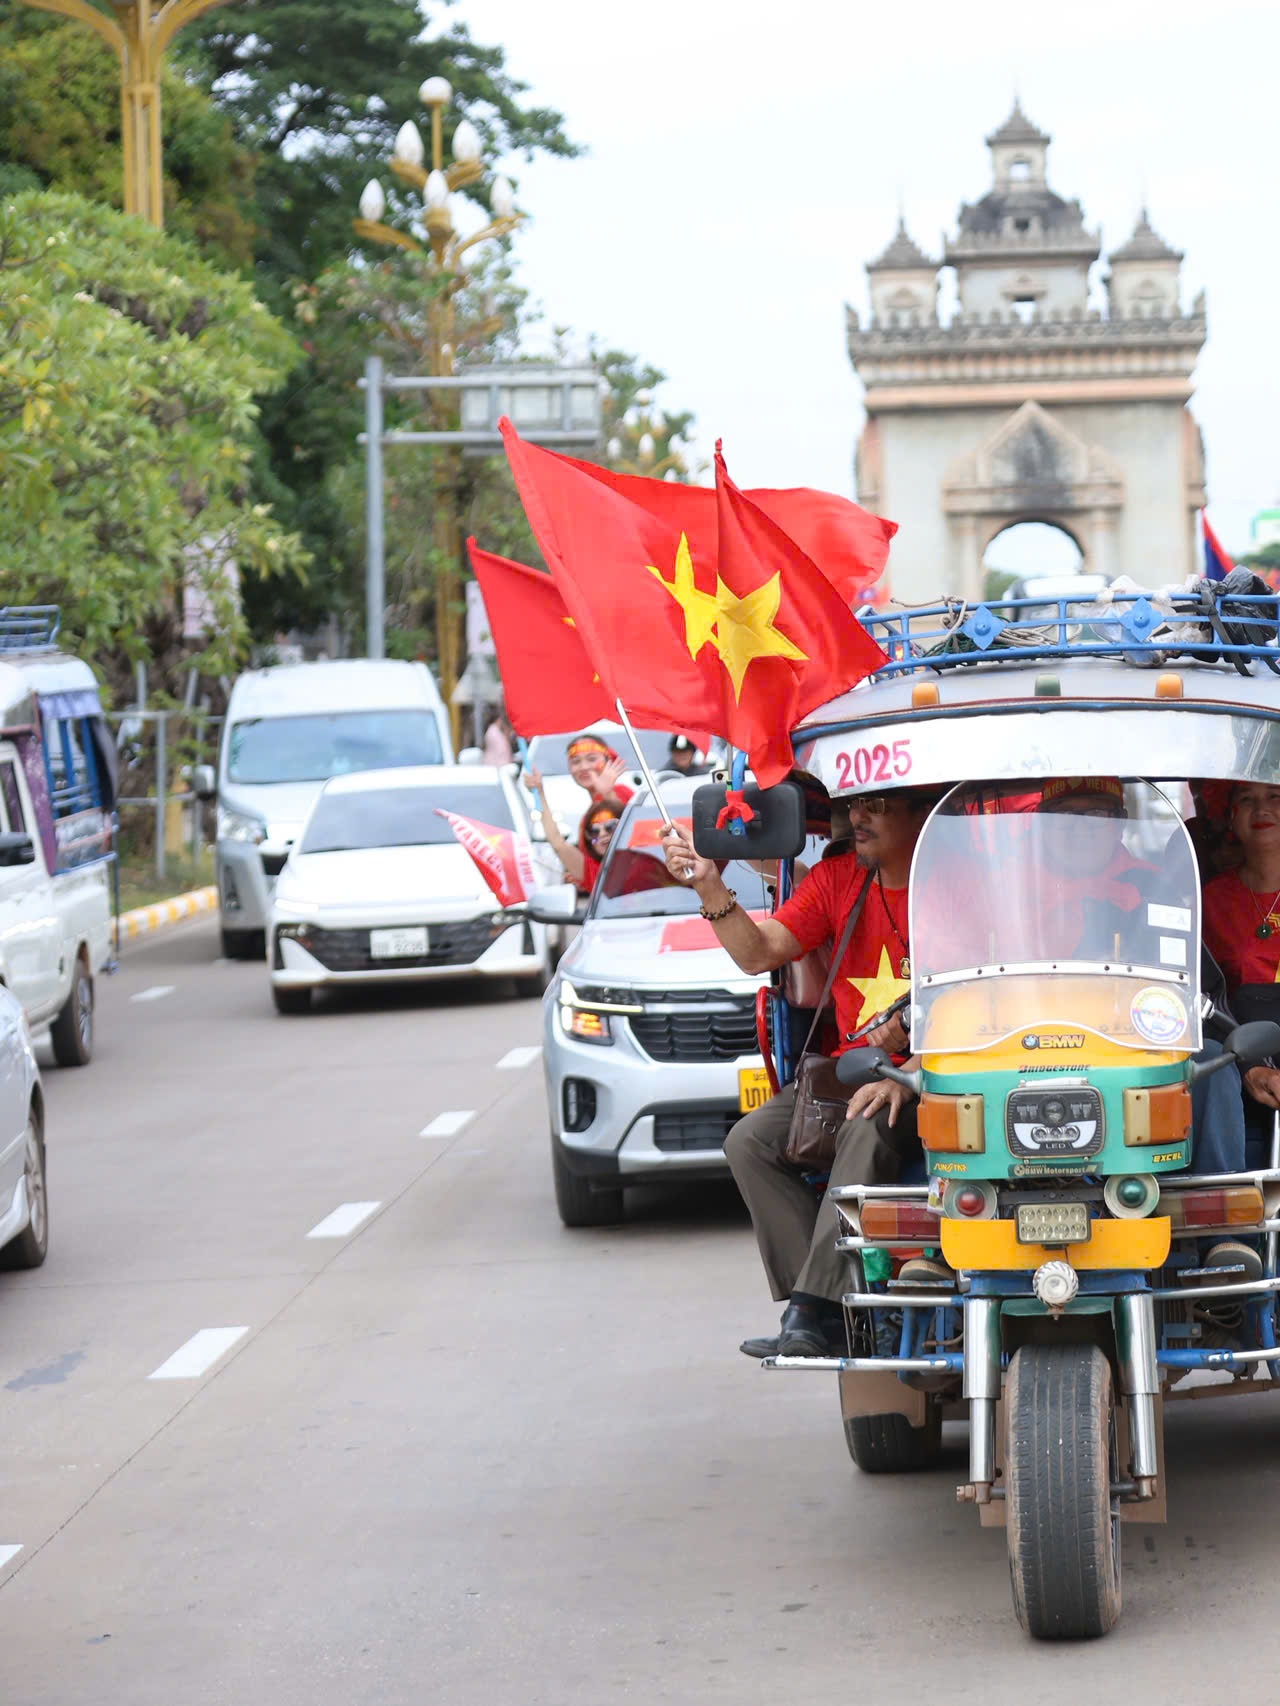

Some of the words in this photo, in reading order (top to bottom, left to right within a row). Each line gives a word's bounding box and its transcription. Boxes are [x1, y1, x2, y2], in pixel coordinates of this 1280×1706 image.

[835, 739, 912, 789] 2025
[1038, 1034, 1085, 1049] BMW
[1018, 1064, 1091, 1074] BRIDGESTONE
[1152, 1151, 1183, 1163] EXCEL
[1025, 1167, 1043, 1175] BMW
[1043, 1167, 1085, 1175] Motorsport
